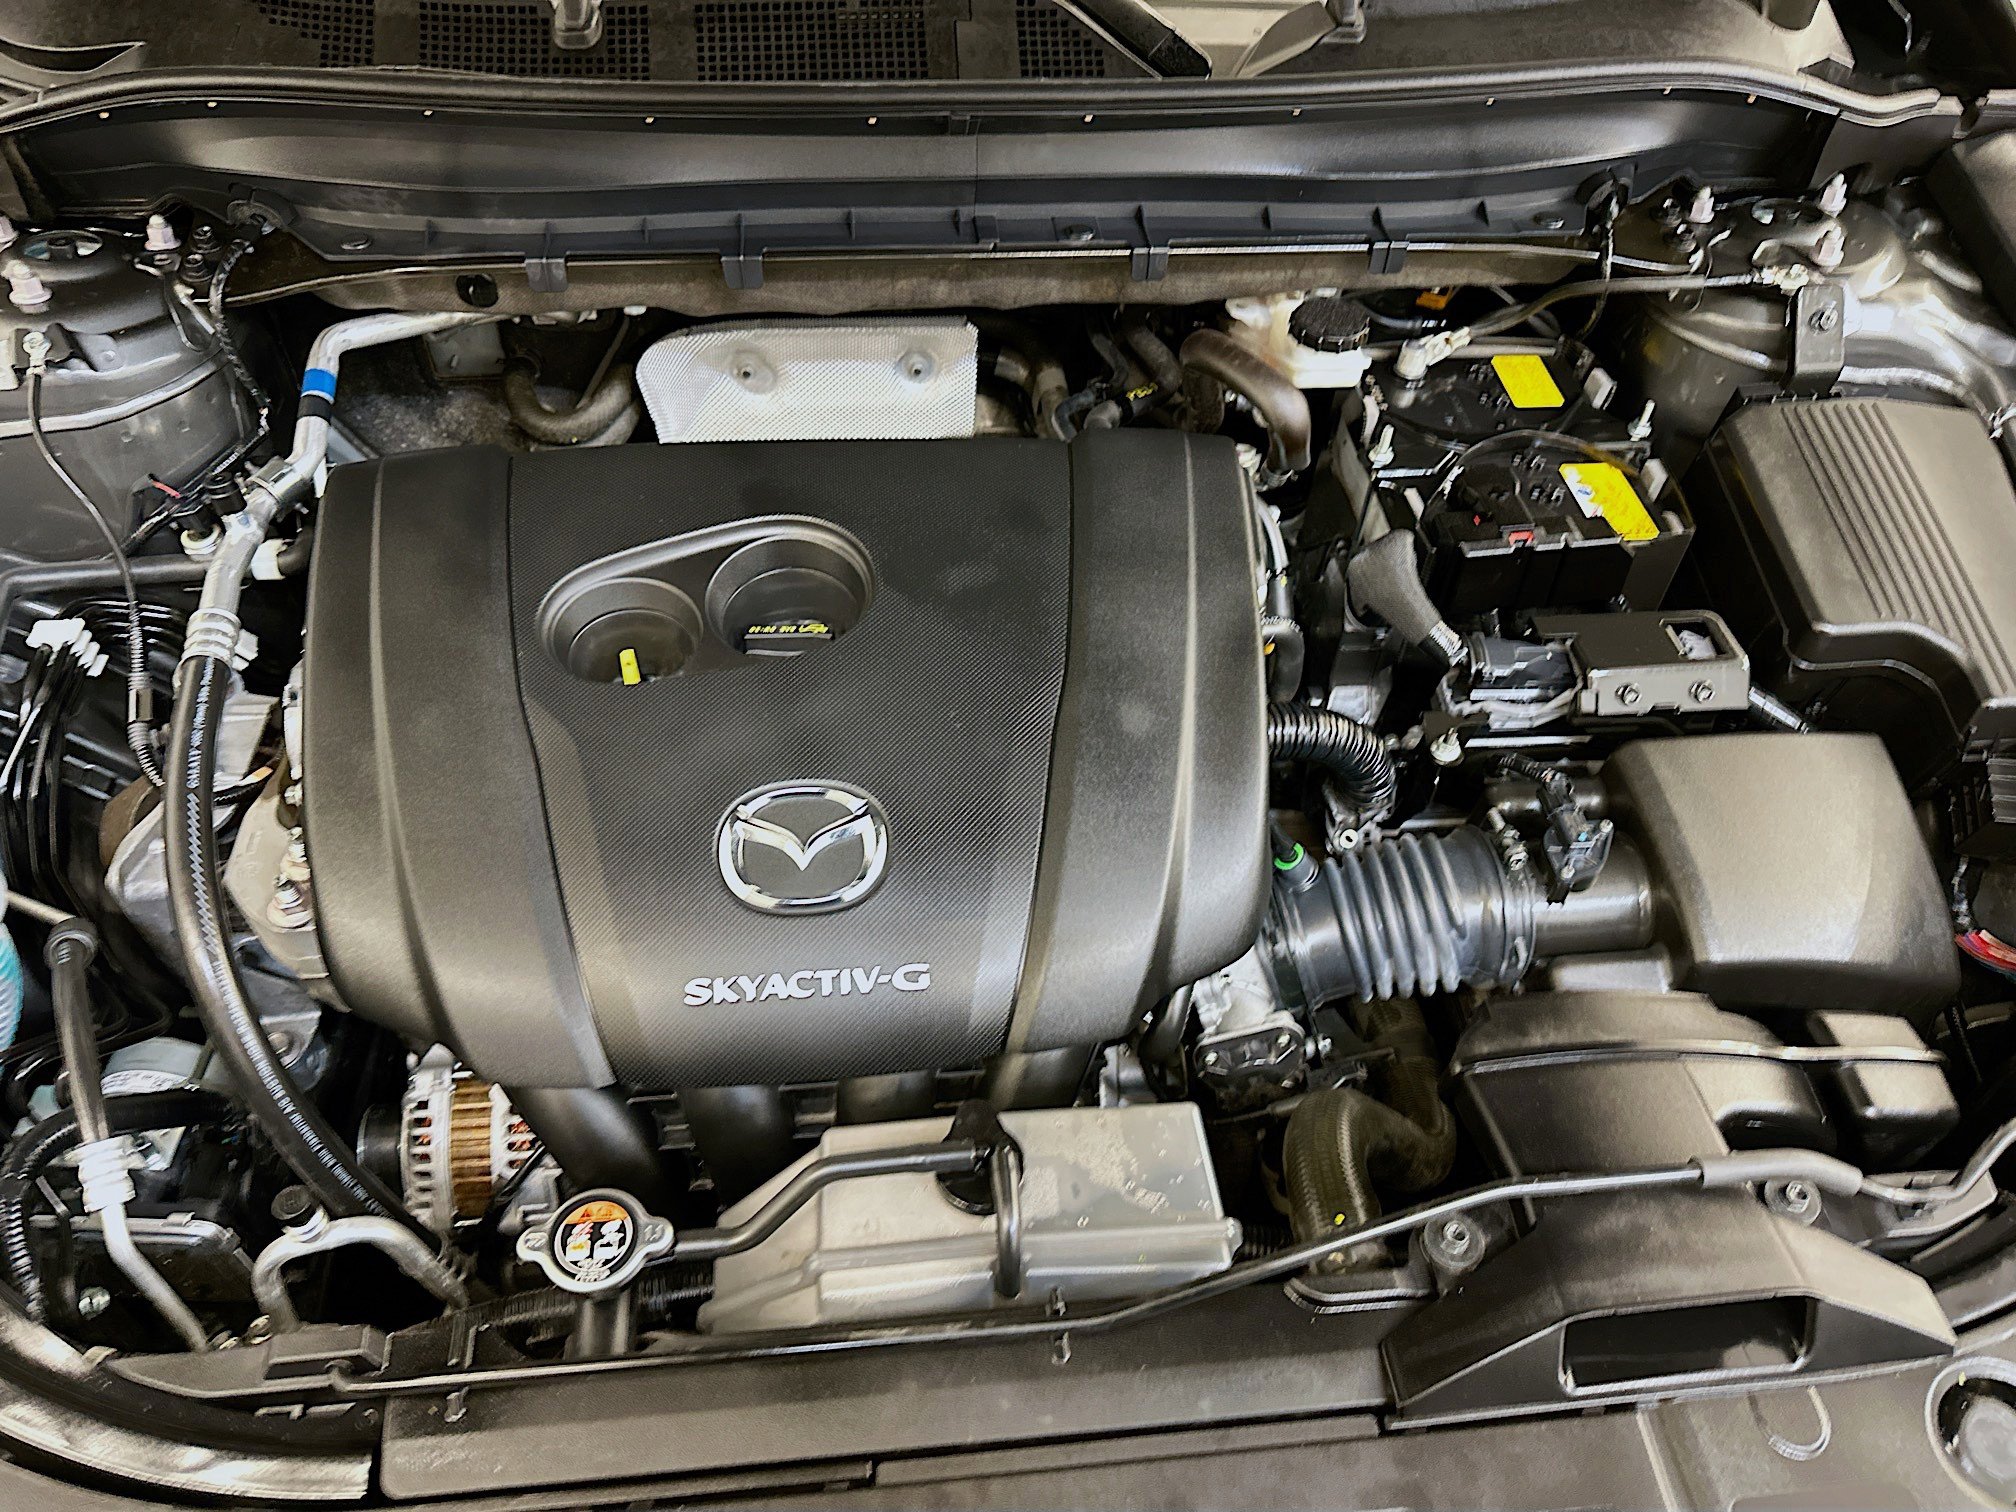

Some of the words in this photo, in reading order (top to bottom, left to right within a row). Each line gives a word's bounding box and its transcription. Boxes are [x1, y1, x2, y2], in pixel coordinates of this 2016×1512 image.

[683, 963, 931, 1006] SKYACTIV-G
[239, 1032, 264, 1062] HOSE
[253, 1058, 287, 1100] SUCTION
